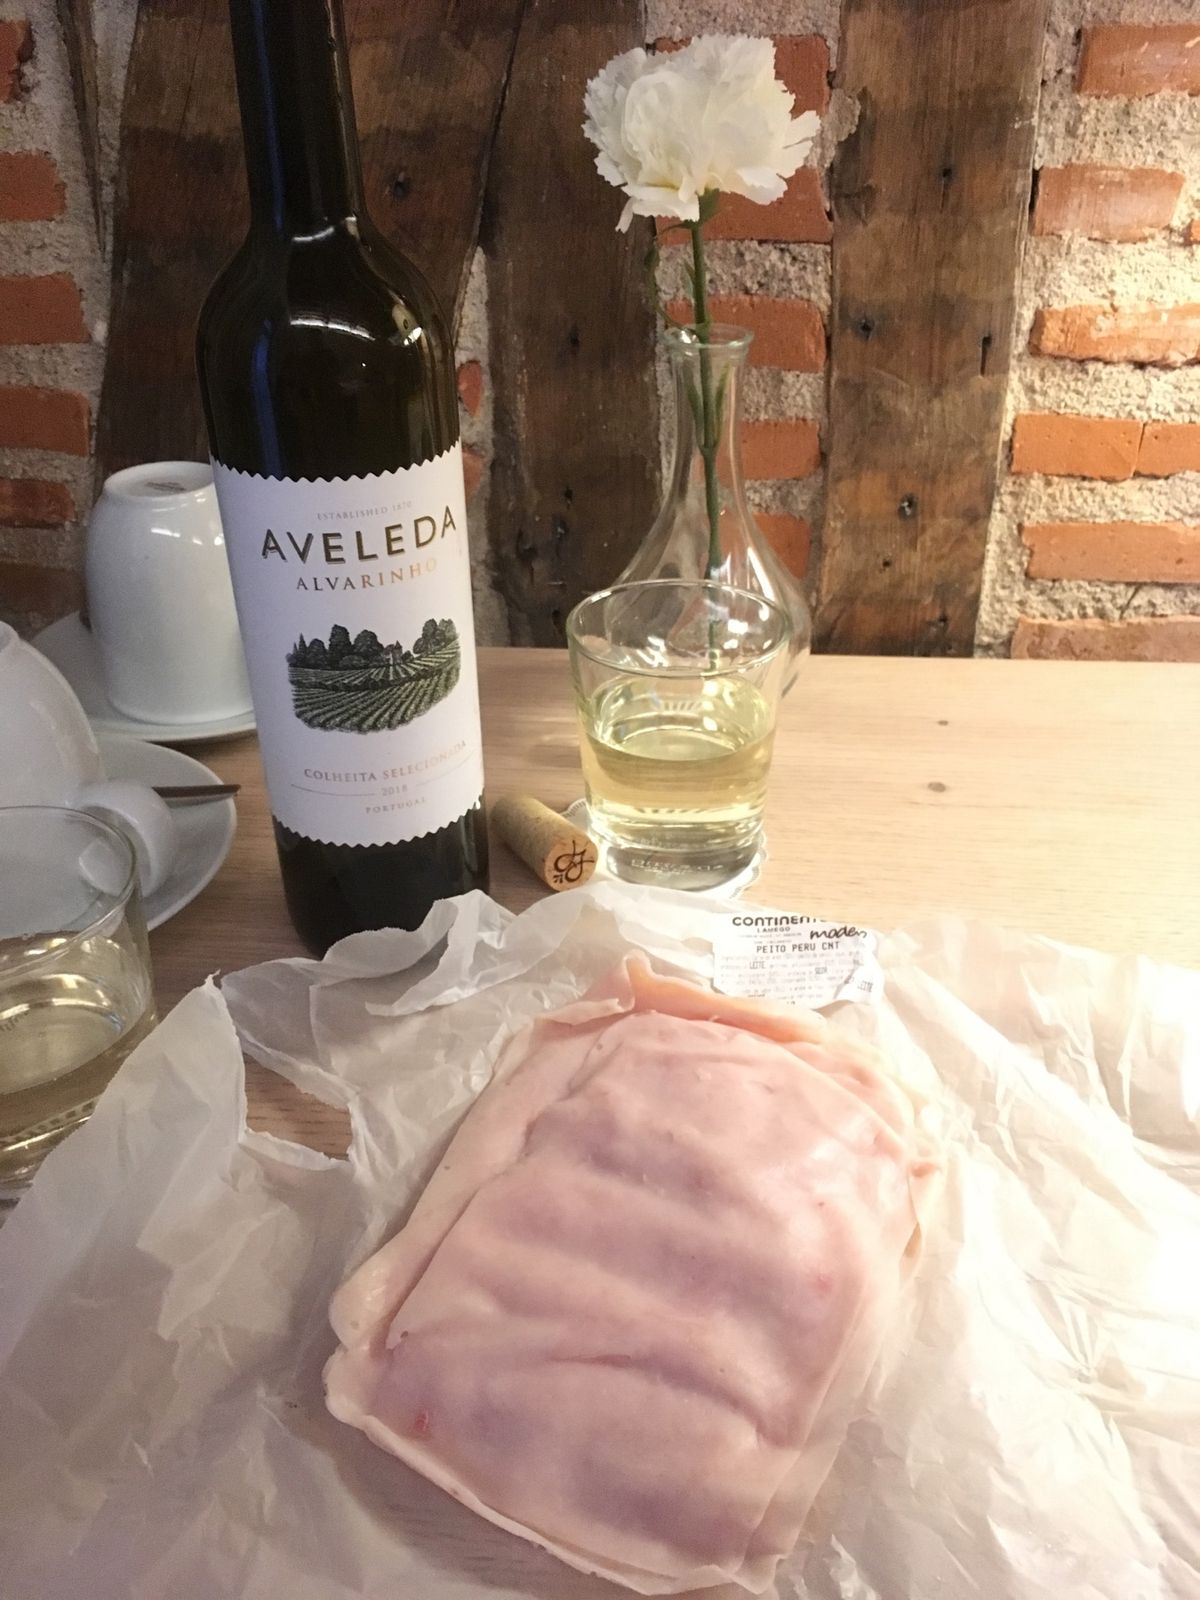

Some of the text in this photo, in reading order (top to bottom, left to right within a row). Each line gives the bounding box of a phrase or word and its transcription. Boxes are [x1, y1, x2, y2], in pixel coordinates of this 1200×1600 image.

[316, 507, 389, 521] ESTABLISHED
[261, 505, 457, 564] AVELEDA
[296, 558, 438, 591] ALVARINHO
[304, 768, 377, 783] COLHEITA
[381, 784, 409, 797] 2018
[365, 797, 427, 815] PORTUGAL
[756, 940, 840, 954] PEITO PERU CNT
